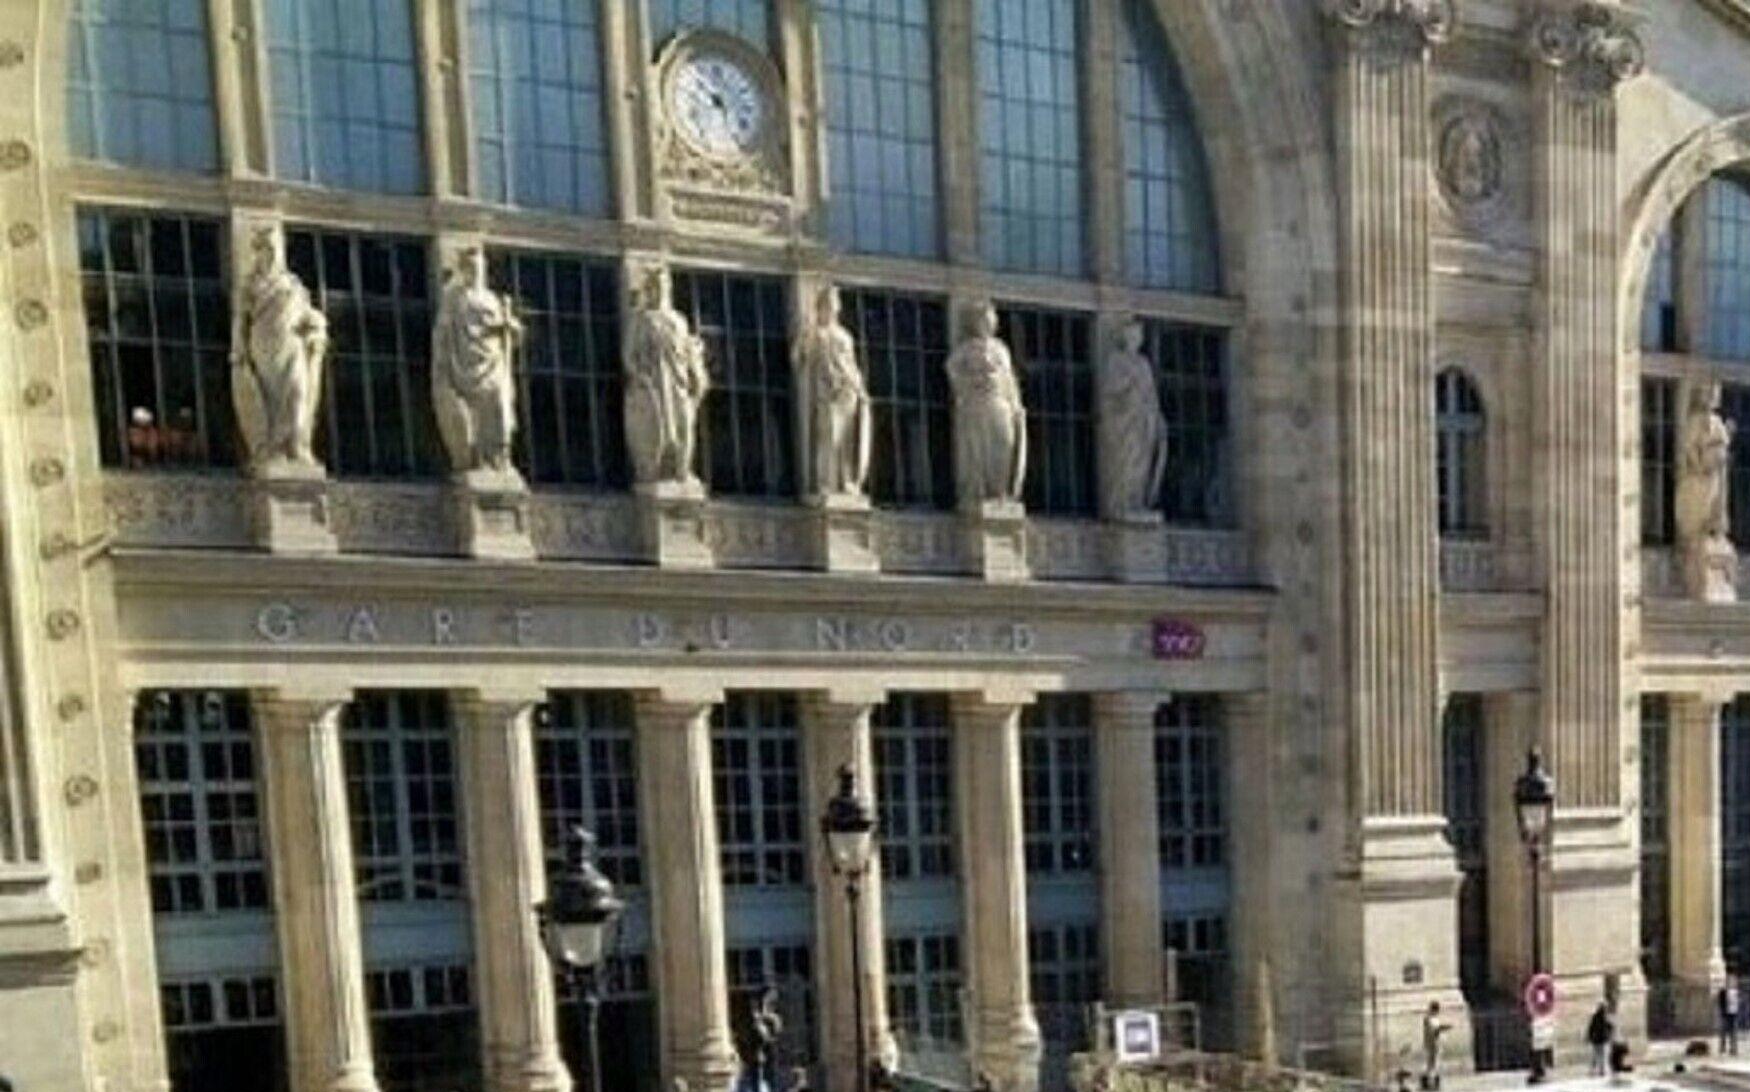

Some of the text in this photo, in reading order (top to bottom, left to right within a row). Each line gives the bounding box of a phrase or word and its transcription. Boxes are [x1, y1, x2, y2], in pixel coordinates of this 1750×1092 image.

[256, 603, 1036, 654] GARE DU NORD
